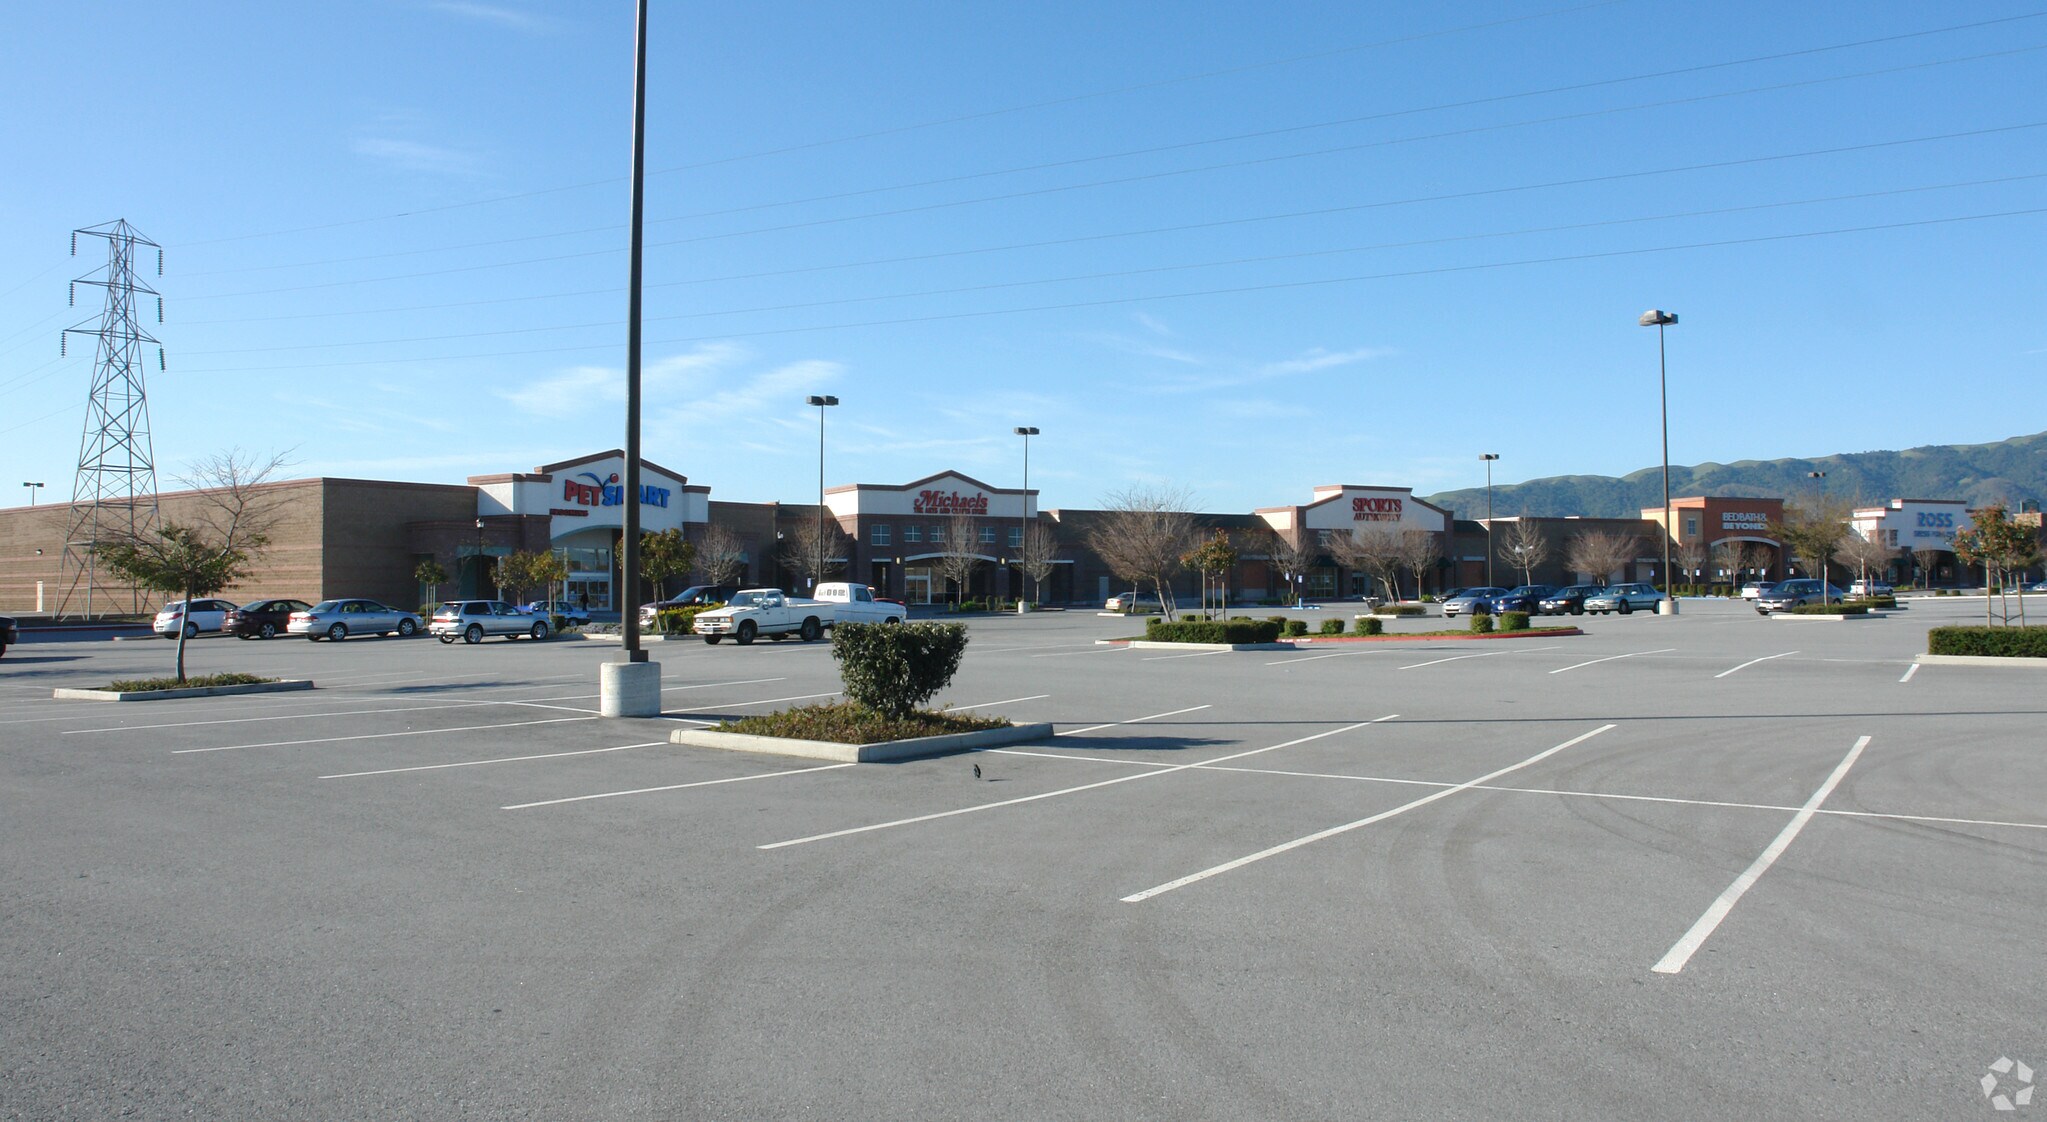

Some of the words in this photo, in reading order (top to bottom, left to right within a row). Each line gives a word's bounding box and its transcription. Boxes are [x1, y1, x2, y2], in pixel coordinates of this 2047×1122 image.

[914, 490, 988, 508] Michaels
[1353, 498, 1402, 512] SPORTS
[1722, 512, 1738, 521] BED
[1739, 512, 1759, 521] BATH
[1917, 512, 1953, 527] ROSS
[1722, 522, 1766, 530] BEYOND
